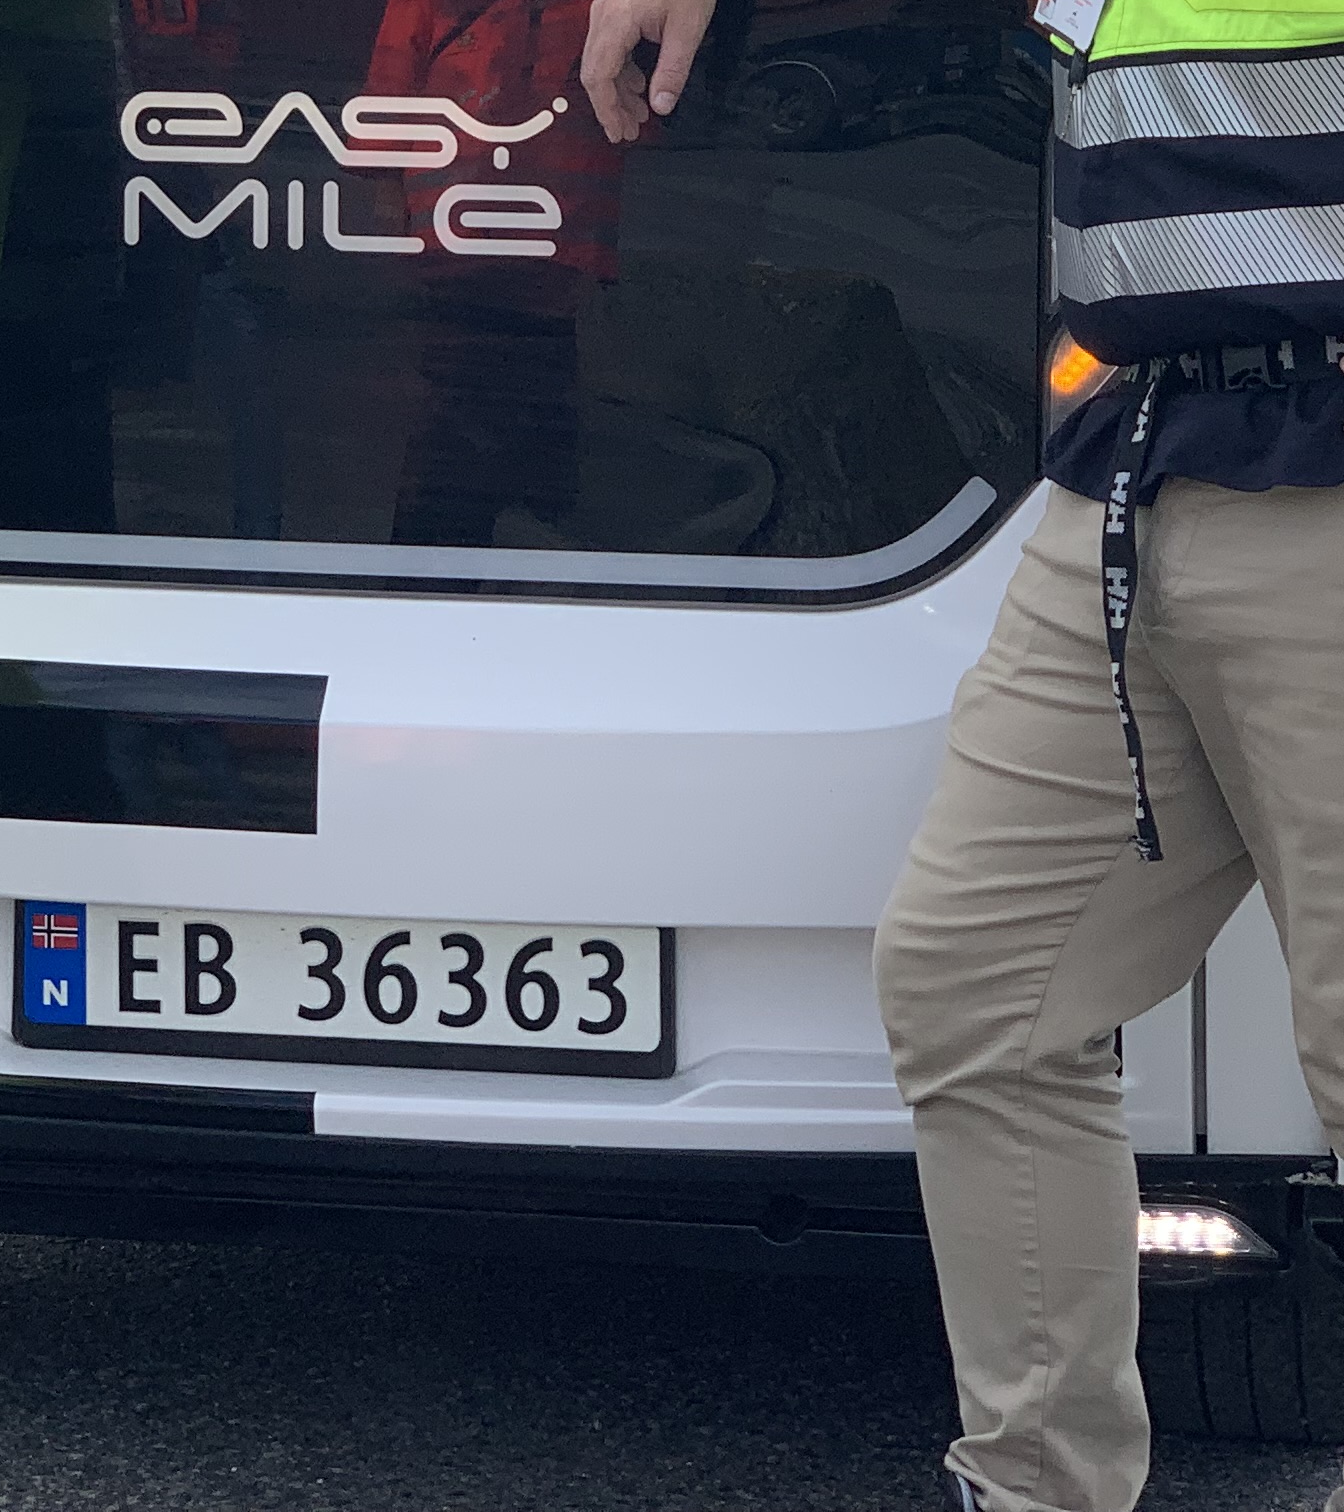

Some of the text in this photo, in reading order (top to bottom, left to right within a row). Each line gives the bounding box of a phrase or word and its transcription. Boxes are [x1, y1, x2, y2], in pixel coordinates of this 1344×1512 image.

[42, 978, 69, 1007] N
[118, 919, 628, 1036] EB 36363
